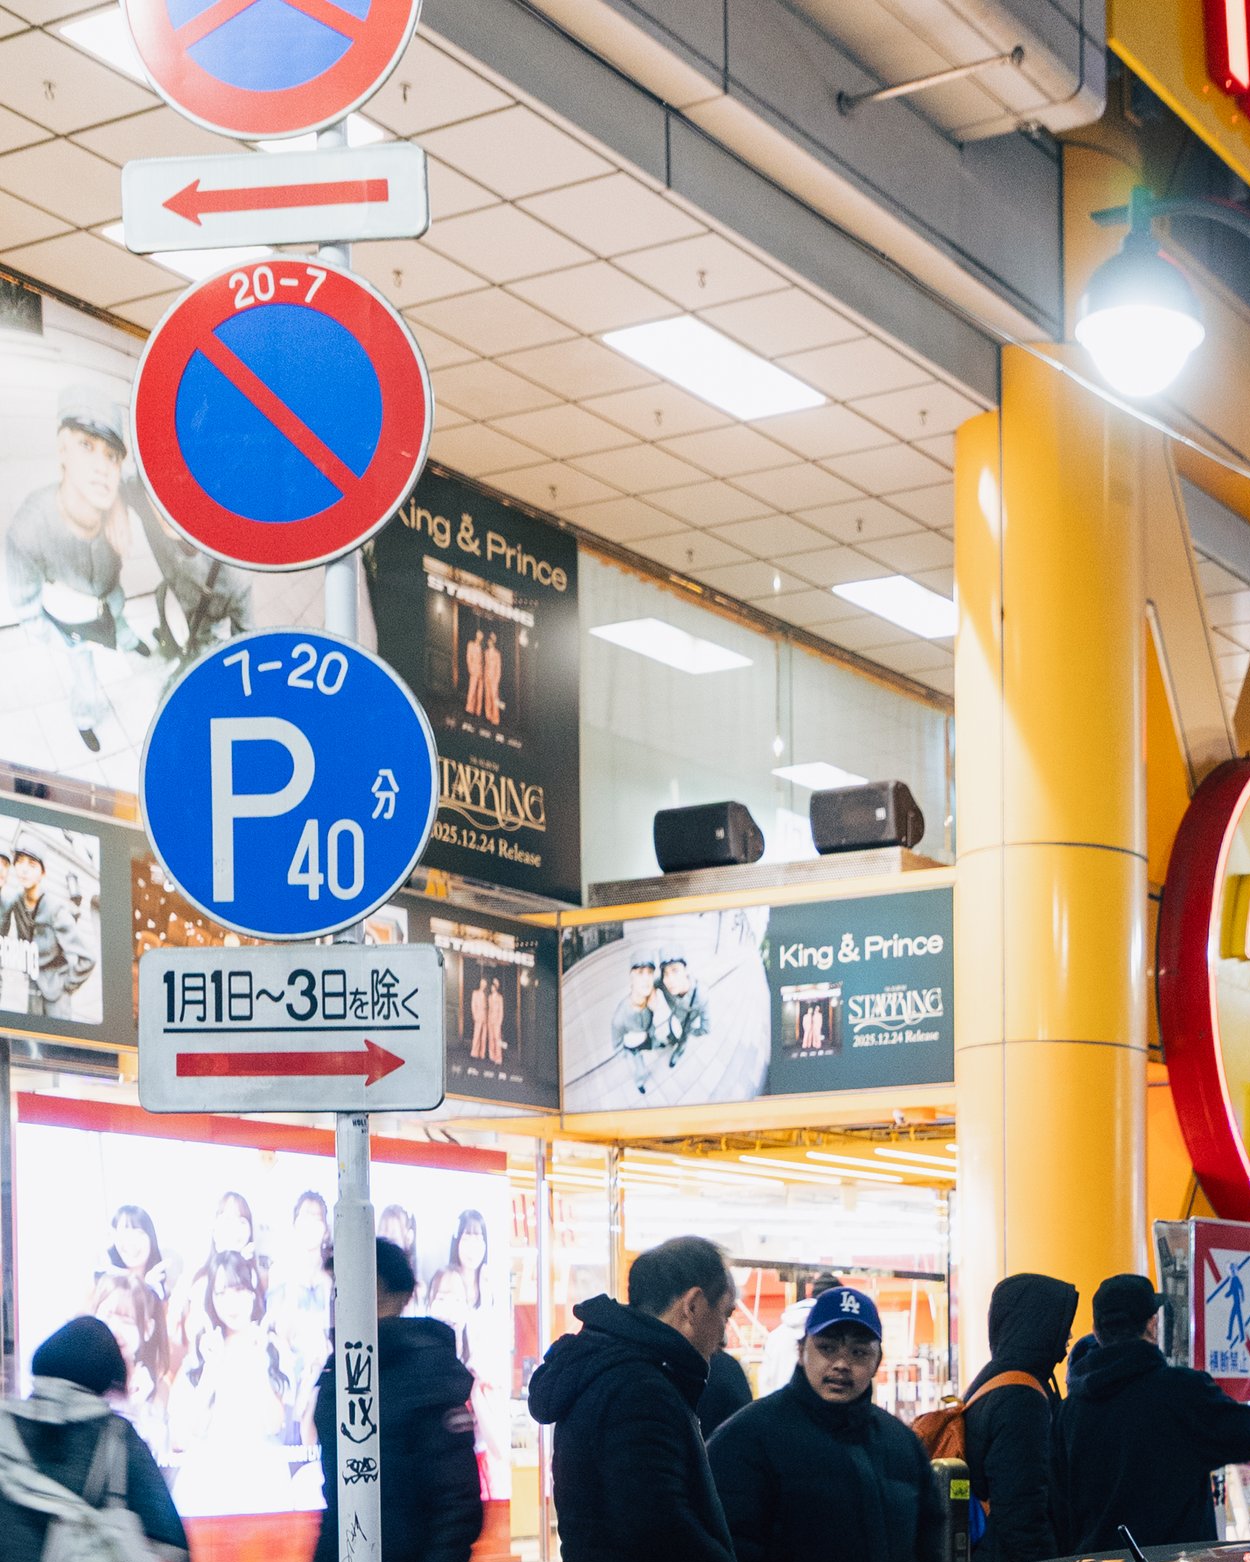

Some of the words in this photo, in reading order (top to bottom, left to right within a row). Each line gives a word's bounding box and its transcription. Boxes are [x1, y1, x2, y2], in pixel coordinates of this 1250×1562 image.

[228, 265, 327, 310] 20-7
[457, 512, 481, 556] &
[487, 530, 568, 592] Prince
[223, 642, 349, 697] 7-20
[210, 716, 315, 903] P
[370, 768, 400, 820] 分
[439, 756, 546, 831] TARRING
[287, 818, 364, 901] 40
[431, 821, 495, 855] 025.12.24
[499, 838, 541, 867] Release
[779, 943, 834, 970] King
[838, 933, 861, 963] &
[864, 933, 944, 961] Prince
[840, 1291, 860, 1314] LA
